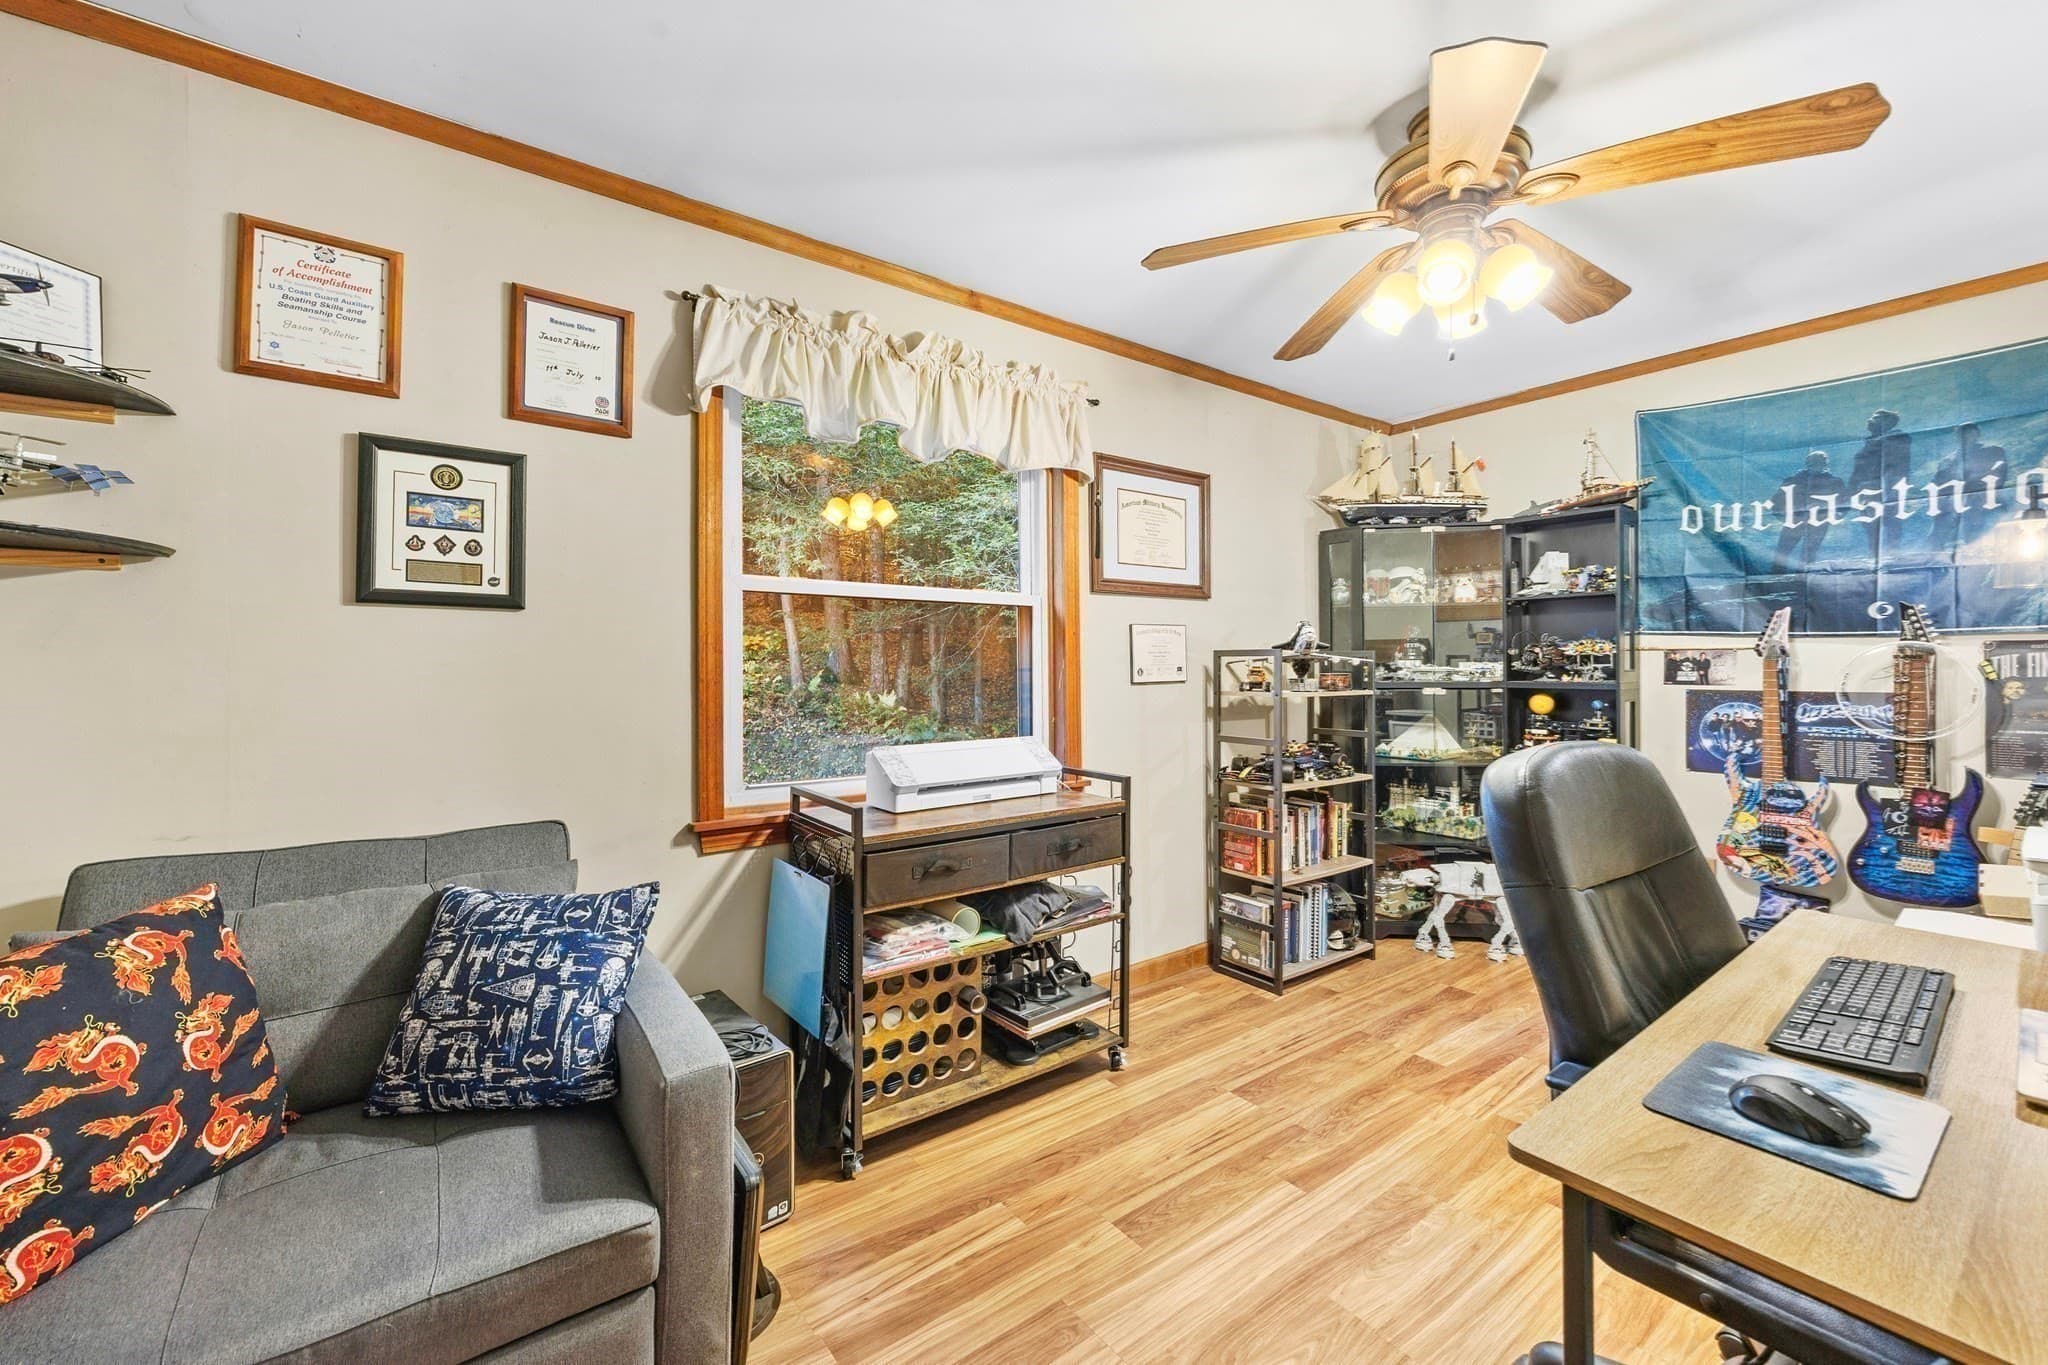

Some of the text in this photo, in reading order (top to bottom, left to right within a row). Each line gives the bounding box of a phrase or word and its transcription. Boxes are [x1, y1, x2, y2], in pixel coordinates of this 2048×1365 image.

[296, 258, 352, 280] Certificate
[272, 266, 285, 277] of
[286, 268, 373, 296] Accomplishment
[281, 292, 364, 316] Boating Skills and
[287, 286, 313, 298] Coast
[313, 291, 340, 303] Guard
[341, 297, 375, 312] Auxiliary
[276, 300, 334, 319] Seamanship
[335, 311, 368, 325] Course
[282, 319, 315, 333] Jason
[319, 325, 361, 342] Pelletier
[549, 316, 596, 333] Rescue Diver
[537, 330, 563, 345] Jason
[565, 368, 585, 380] July
[1989, 652, 2021, 680] THE
